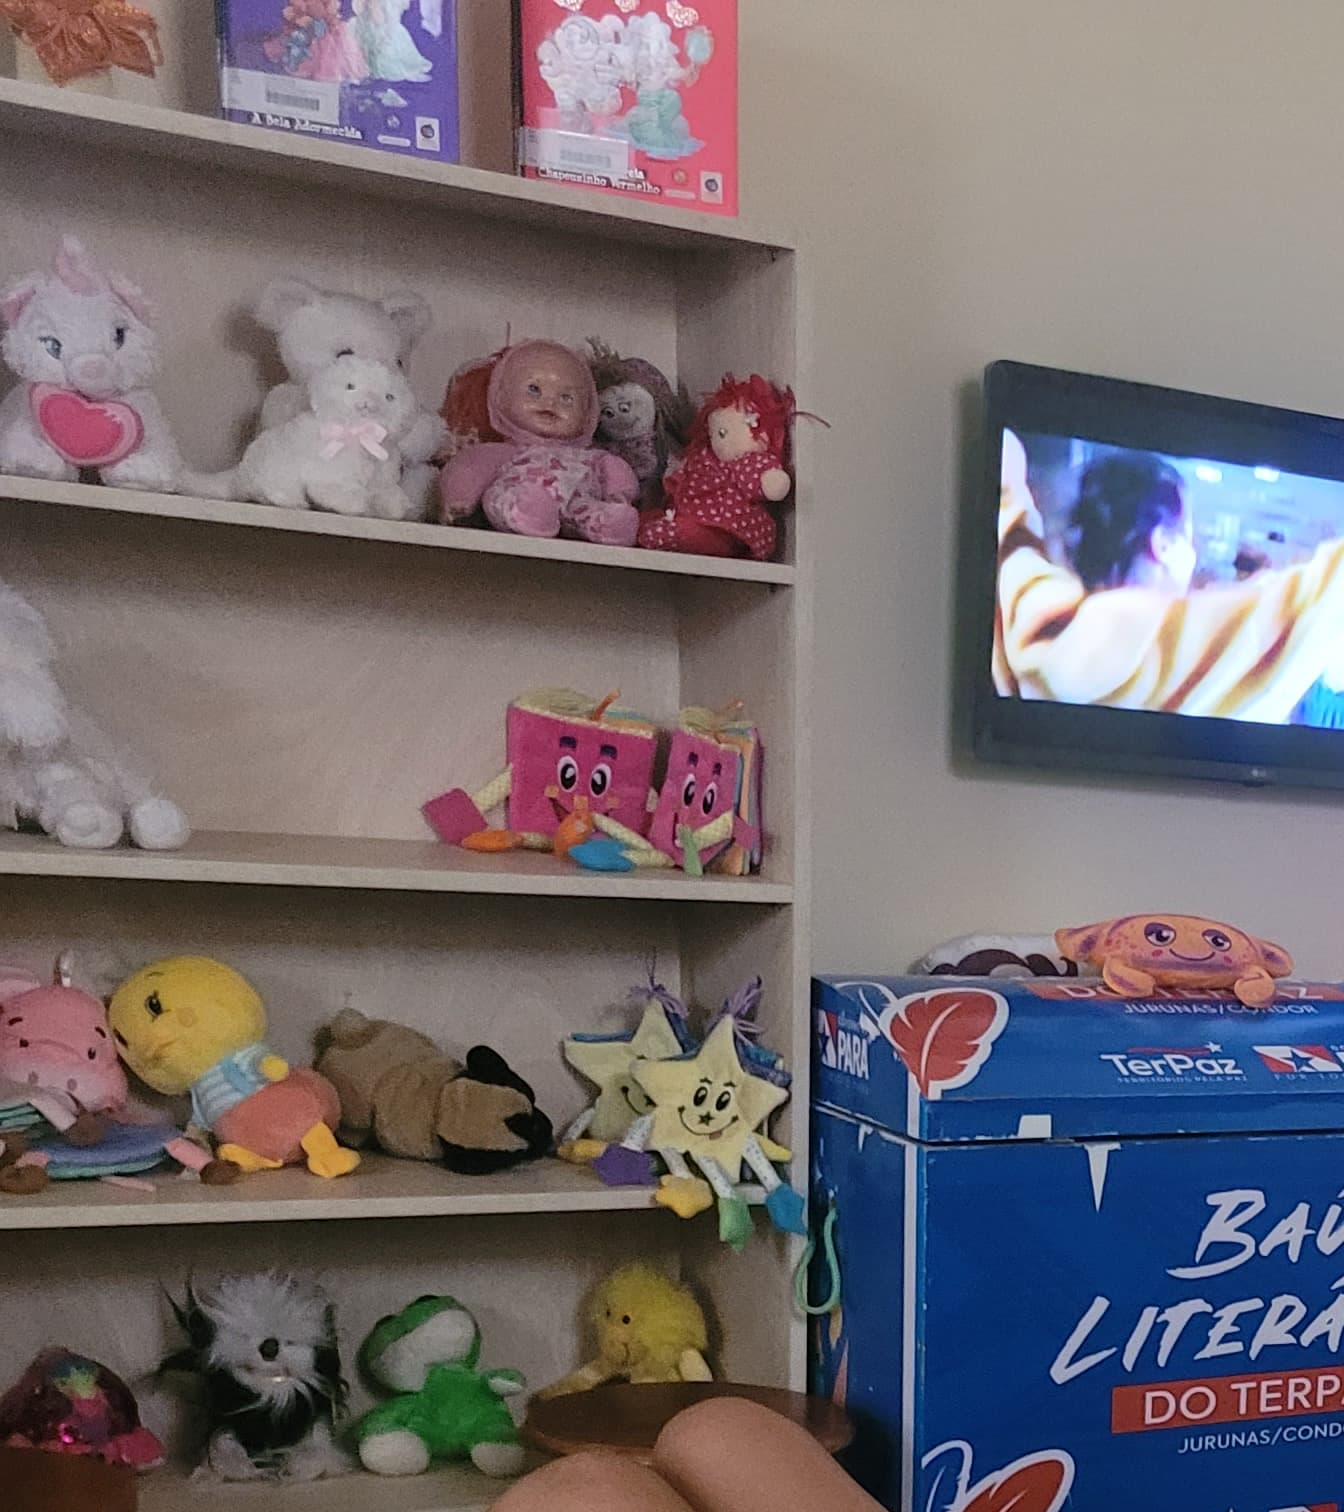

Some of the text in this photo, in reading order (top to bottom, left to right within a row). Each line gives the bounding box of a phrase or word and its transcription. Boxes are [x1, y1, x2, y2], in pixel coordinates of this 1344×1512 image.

[251, 112, 362, 139] A Bela Adormecida
[1100, 1053, 1244, 1076] TerPaz
[1144, 1386, 1218, 1426] DO
